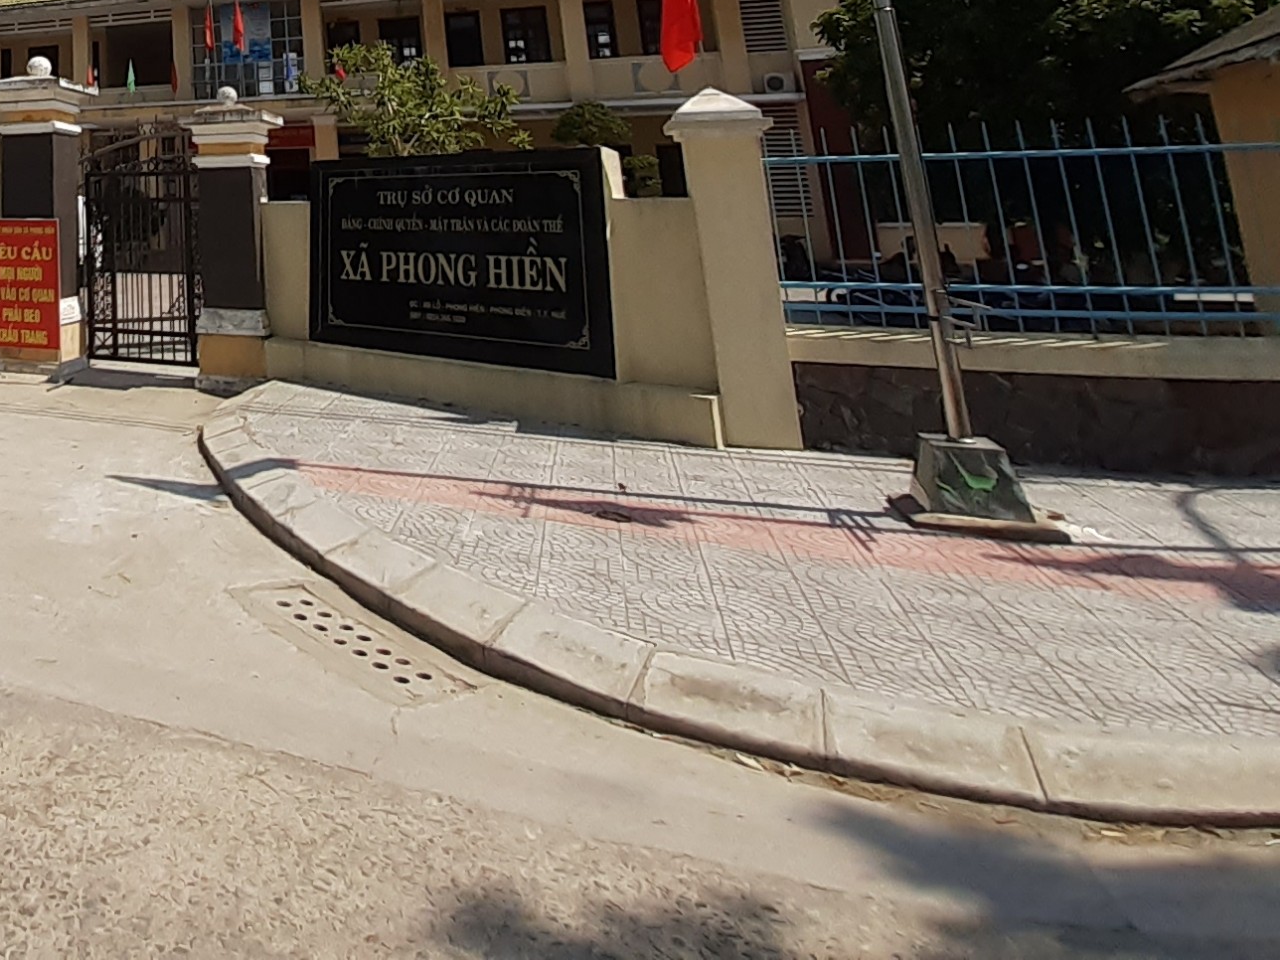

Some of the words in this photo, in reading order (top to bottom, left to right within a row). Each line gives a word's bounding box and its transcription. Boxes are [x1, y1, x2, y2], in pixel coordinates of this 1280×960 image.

[376, 190, 408, 209] TRỤ
[411, 184, 433, 205] SỞ
[436, 187, 460, 205] CƠ
[464, 188, 514, 207] QUAN
[490, 215, 510, 233] CÁC
[339, 241, 373, 281] XÃ
[378, 250, 477, 288] PHONG
[485, 236, 568, 293] HIỀN
[31, 288, 55, 304] QUAN
[20, 329, 49, 346] TRANG
